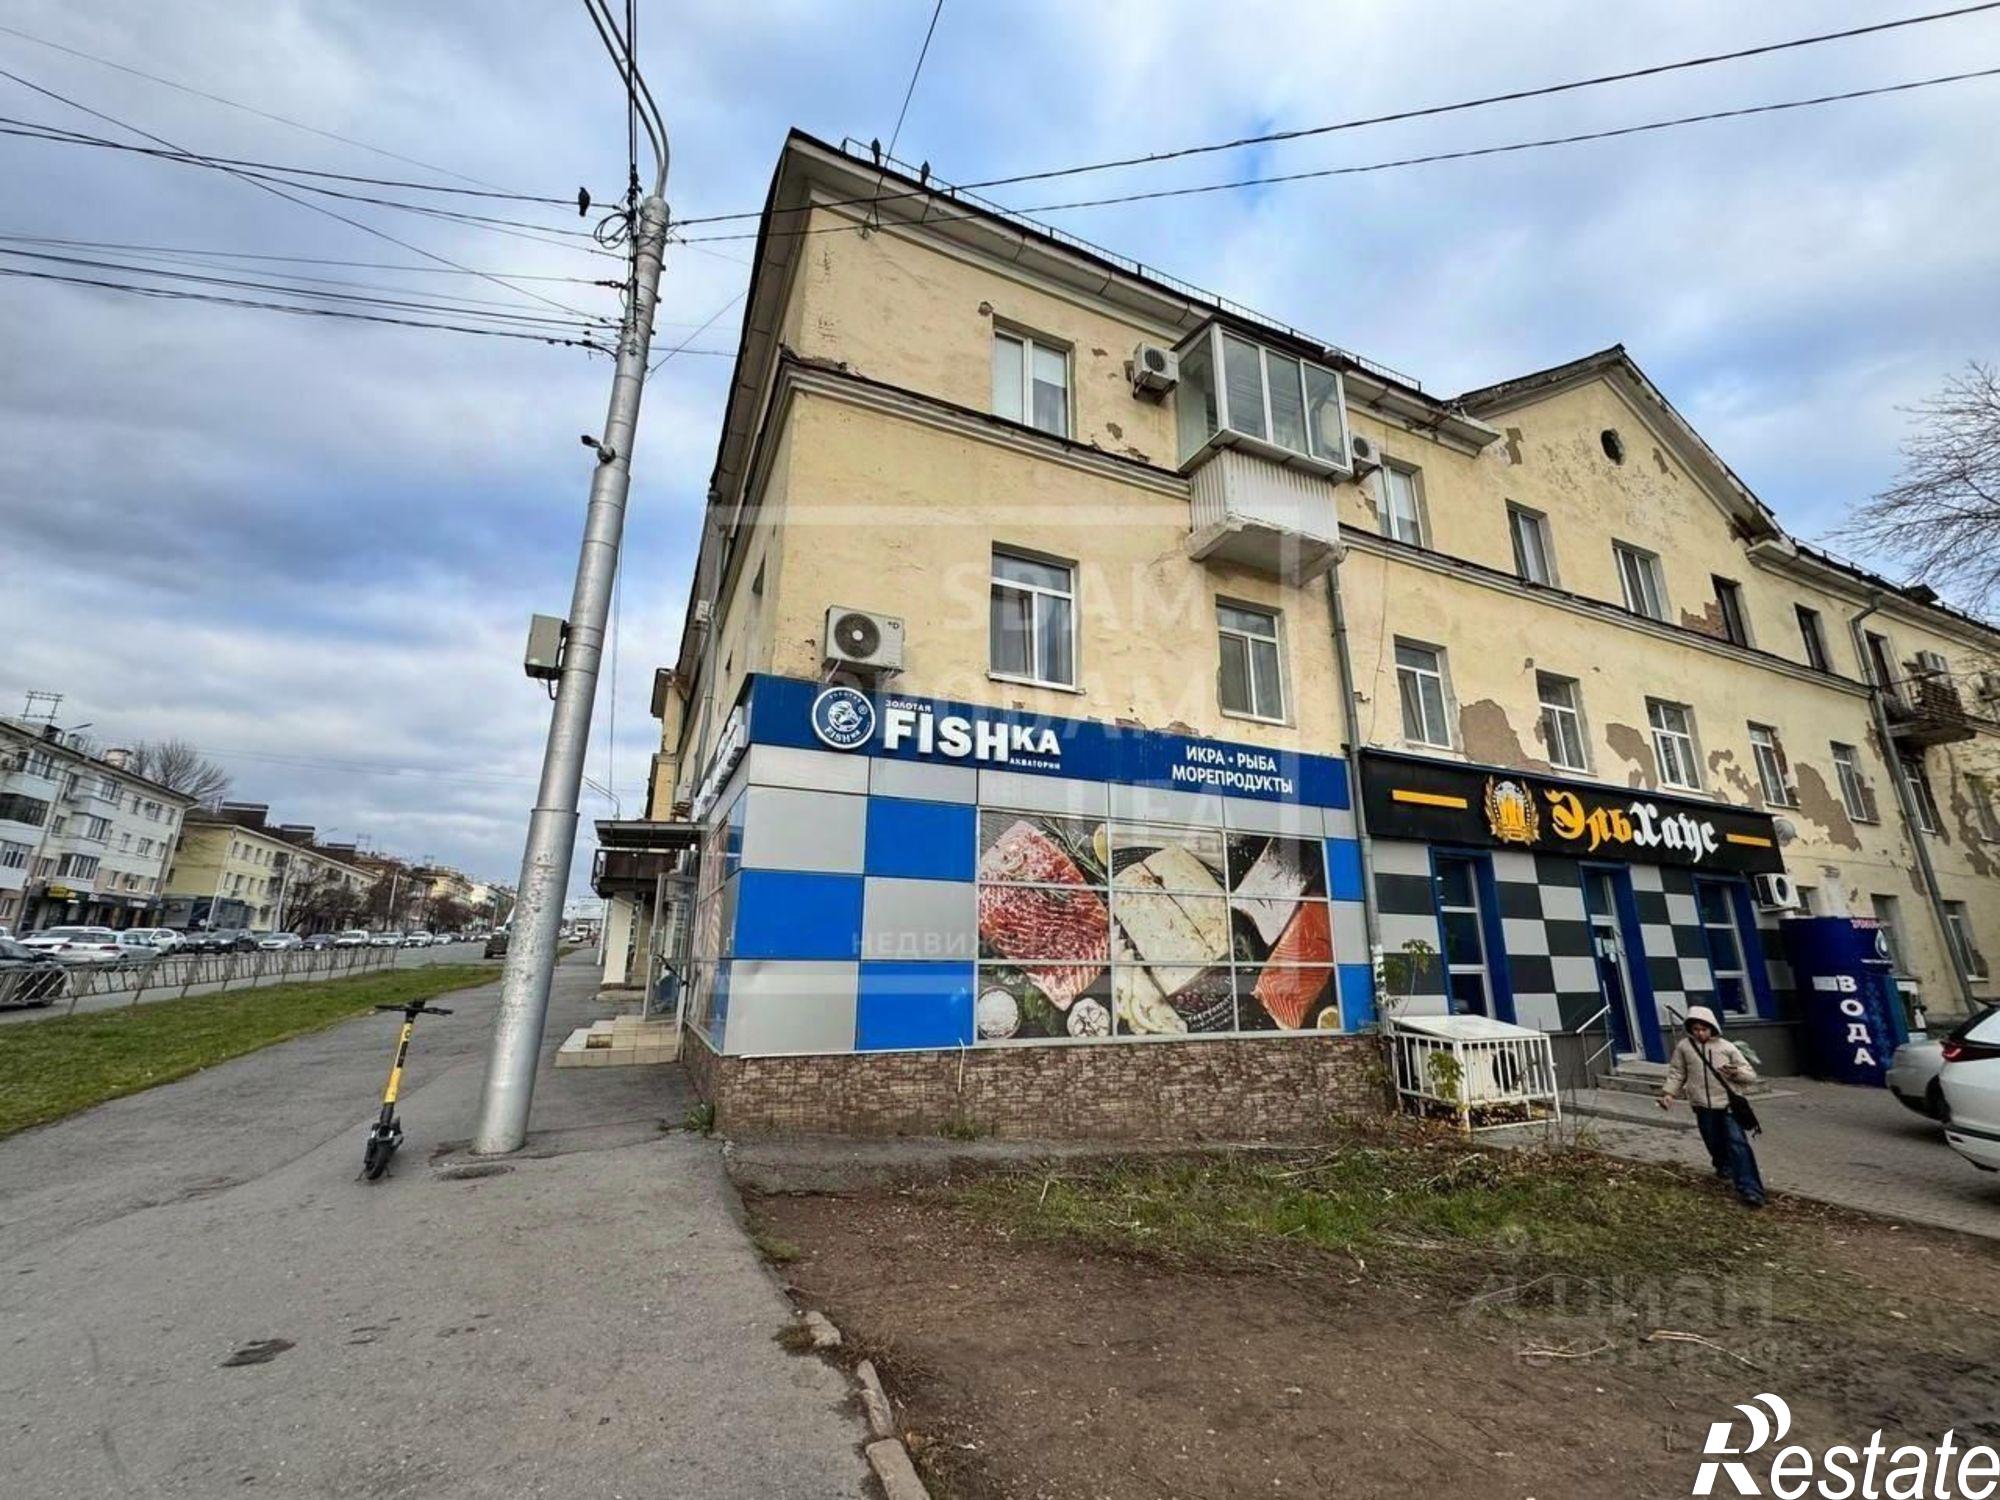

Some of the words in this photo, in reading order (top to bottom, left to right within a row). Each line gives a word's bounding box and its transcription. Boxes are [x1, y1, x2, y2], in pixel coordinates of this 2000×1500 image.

[885, 699, 932, 713] ЗОЛОТАЯ
[1186, 745, 1226, 766] ИКРА
[1237, 752, 1277, 773] РЫБА
[1171, 764, 1293, 794] МОРЕПРОДУКТЫ
[1836, 975, 1876, 1066] ВОДА
